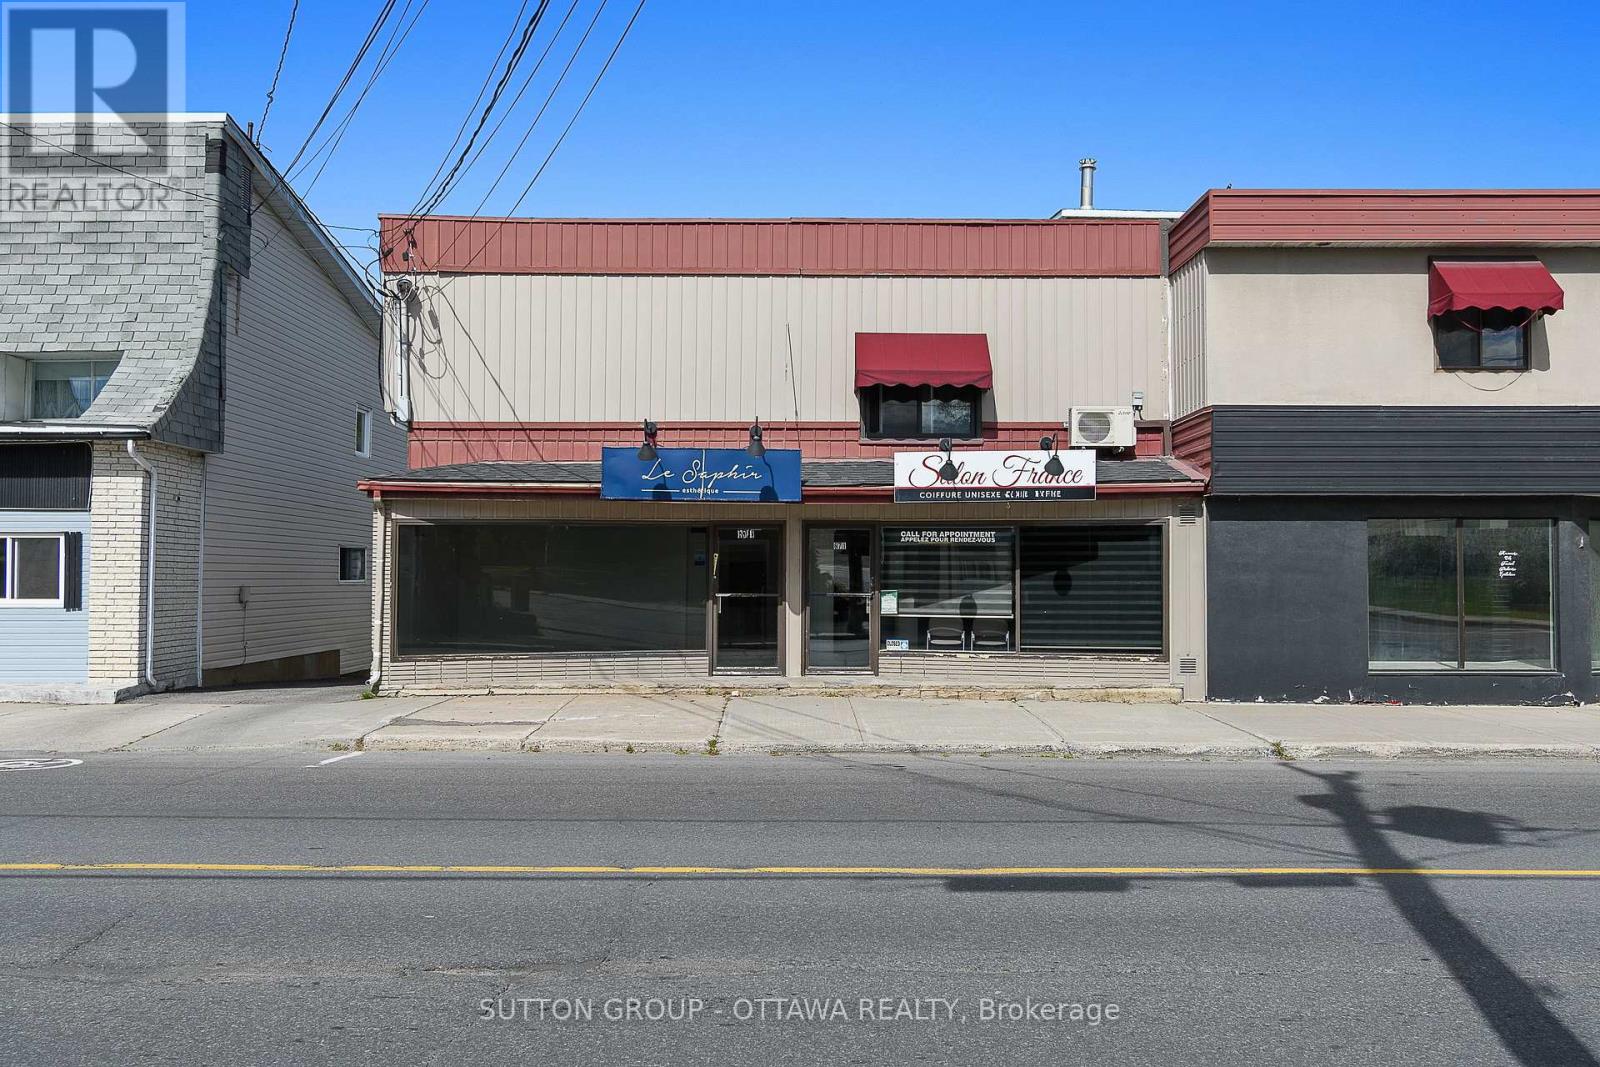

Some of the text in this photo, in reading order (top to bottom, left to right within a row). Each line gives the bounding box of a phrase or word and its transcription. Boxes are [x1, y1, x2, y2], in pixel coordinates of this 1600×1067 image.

[641, 458, 762, 488] Le Saphir
[919, 491, 962, 499] COIFFURE
[965, 491, 1001, 499] UNISEXE
